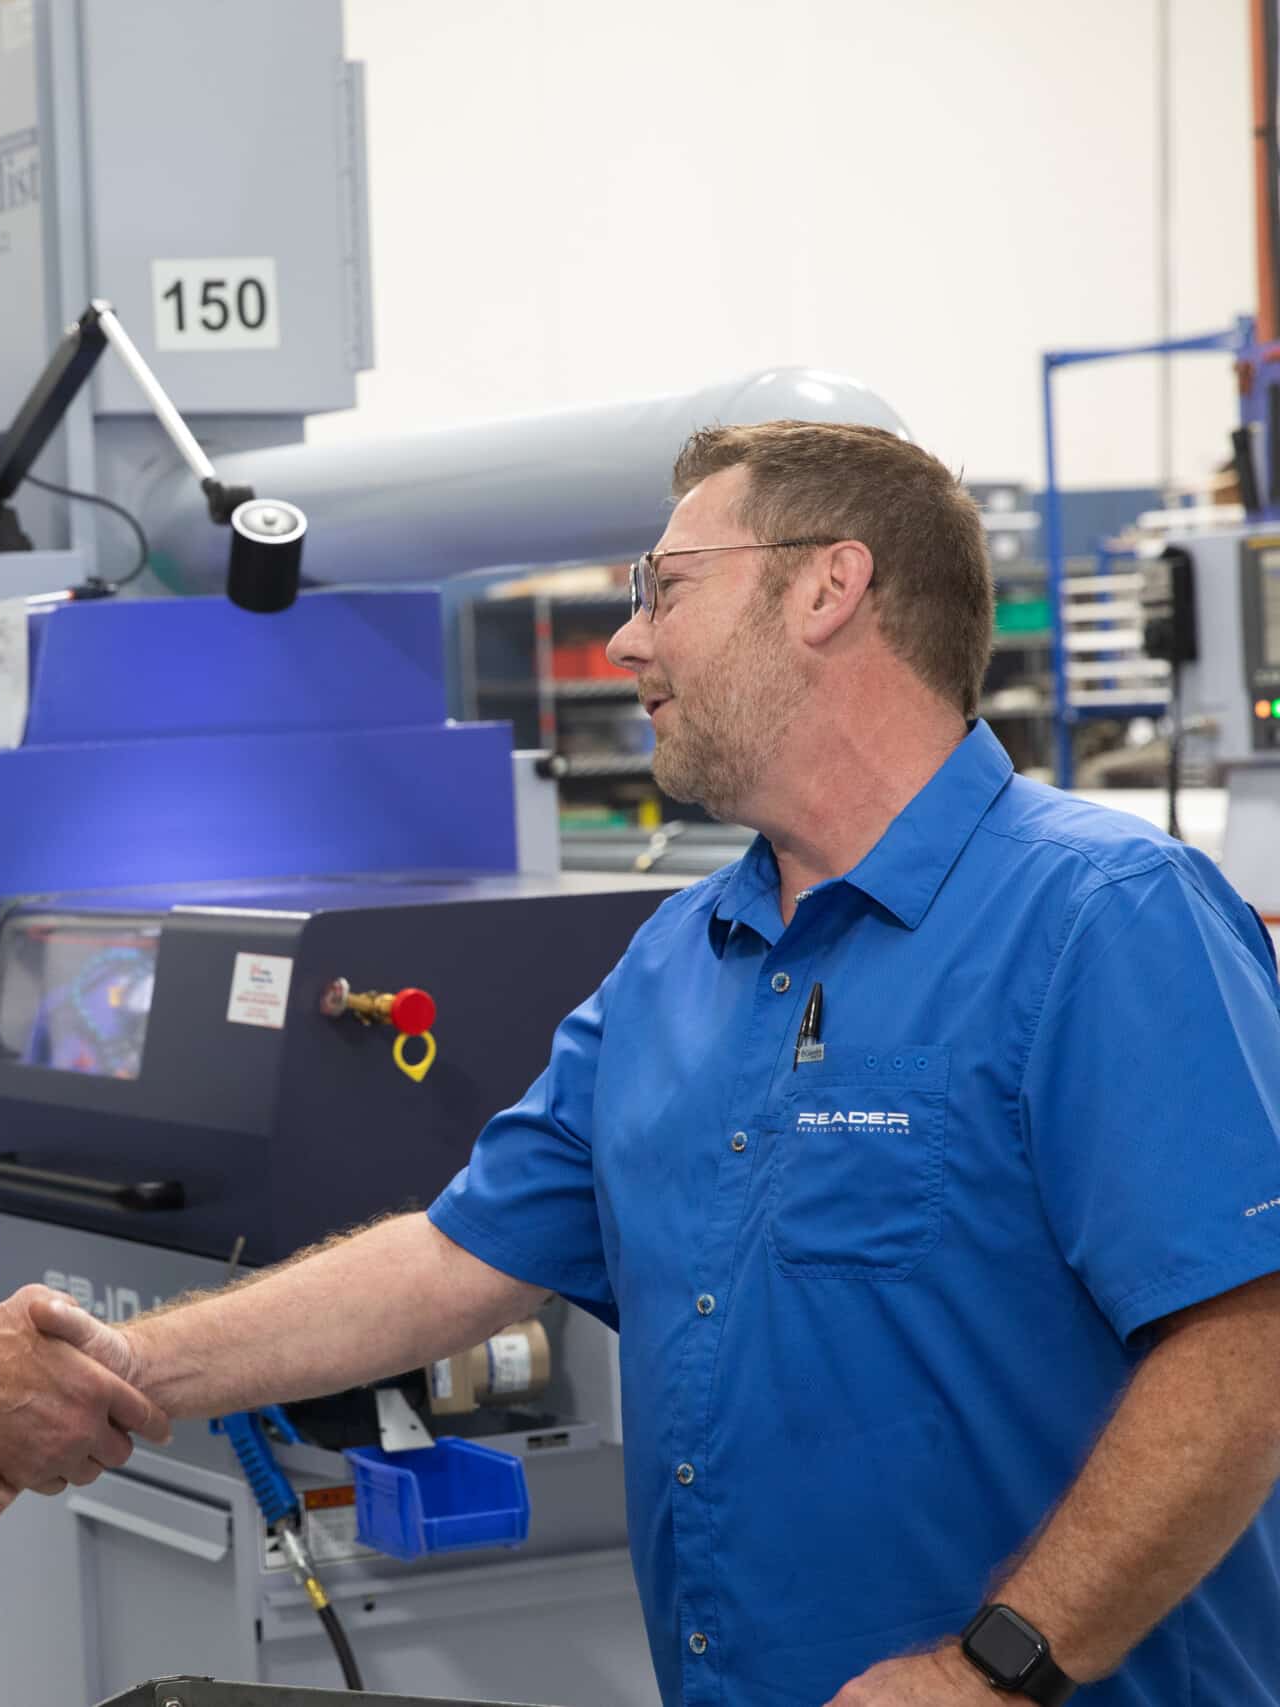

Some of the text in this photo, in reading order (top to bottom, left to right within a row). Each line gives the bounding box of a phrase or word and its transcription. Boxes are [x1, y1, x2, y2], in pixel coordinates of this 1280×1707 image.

[162, 277, 266, 332] 150
[797, 1111, 910, 1126] READER
[847, 1125, 910, 1135] SOLUTIONS
